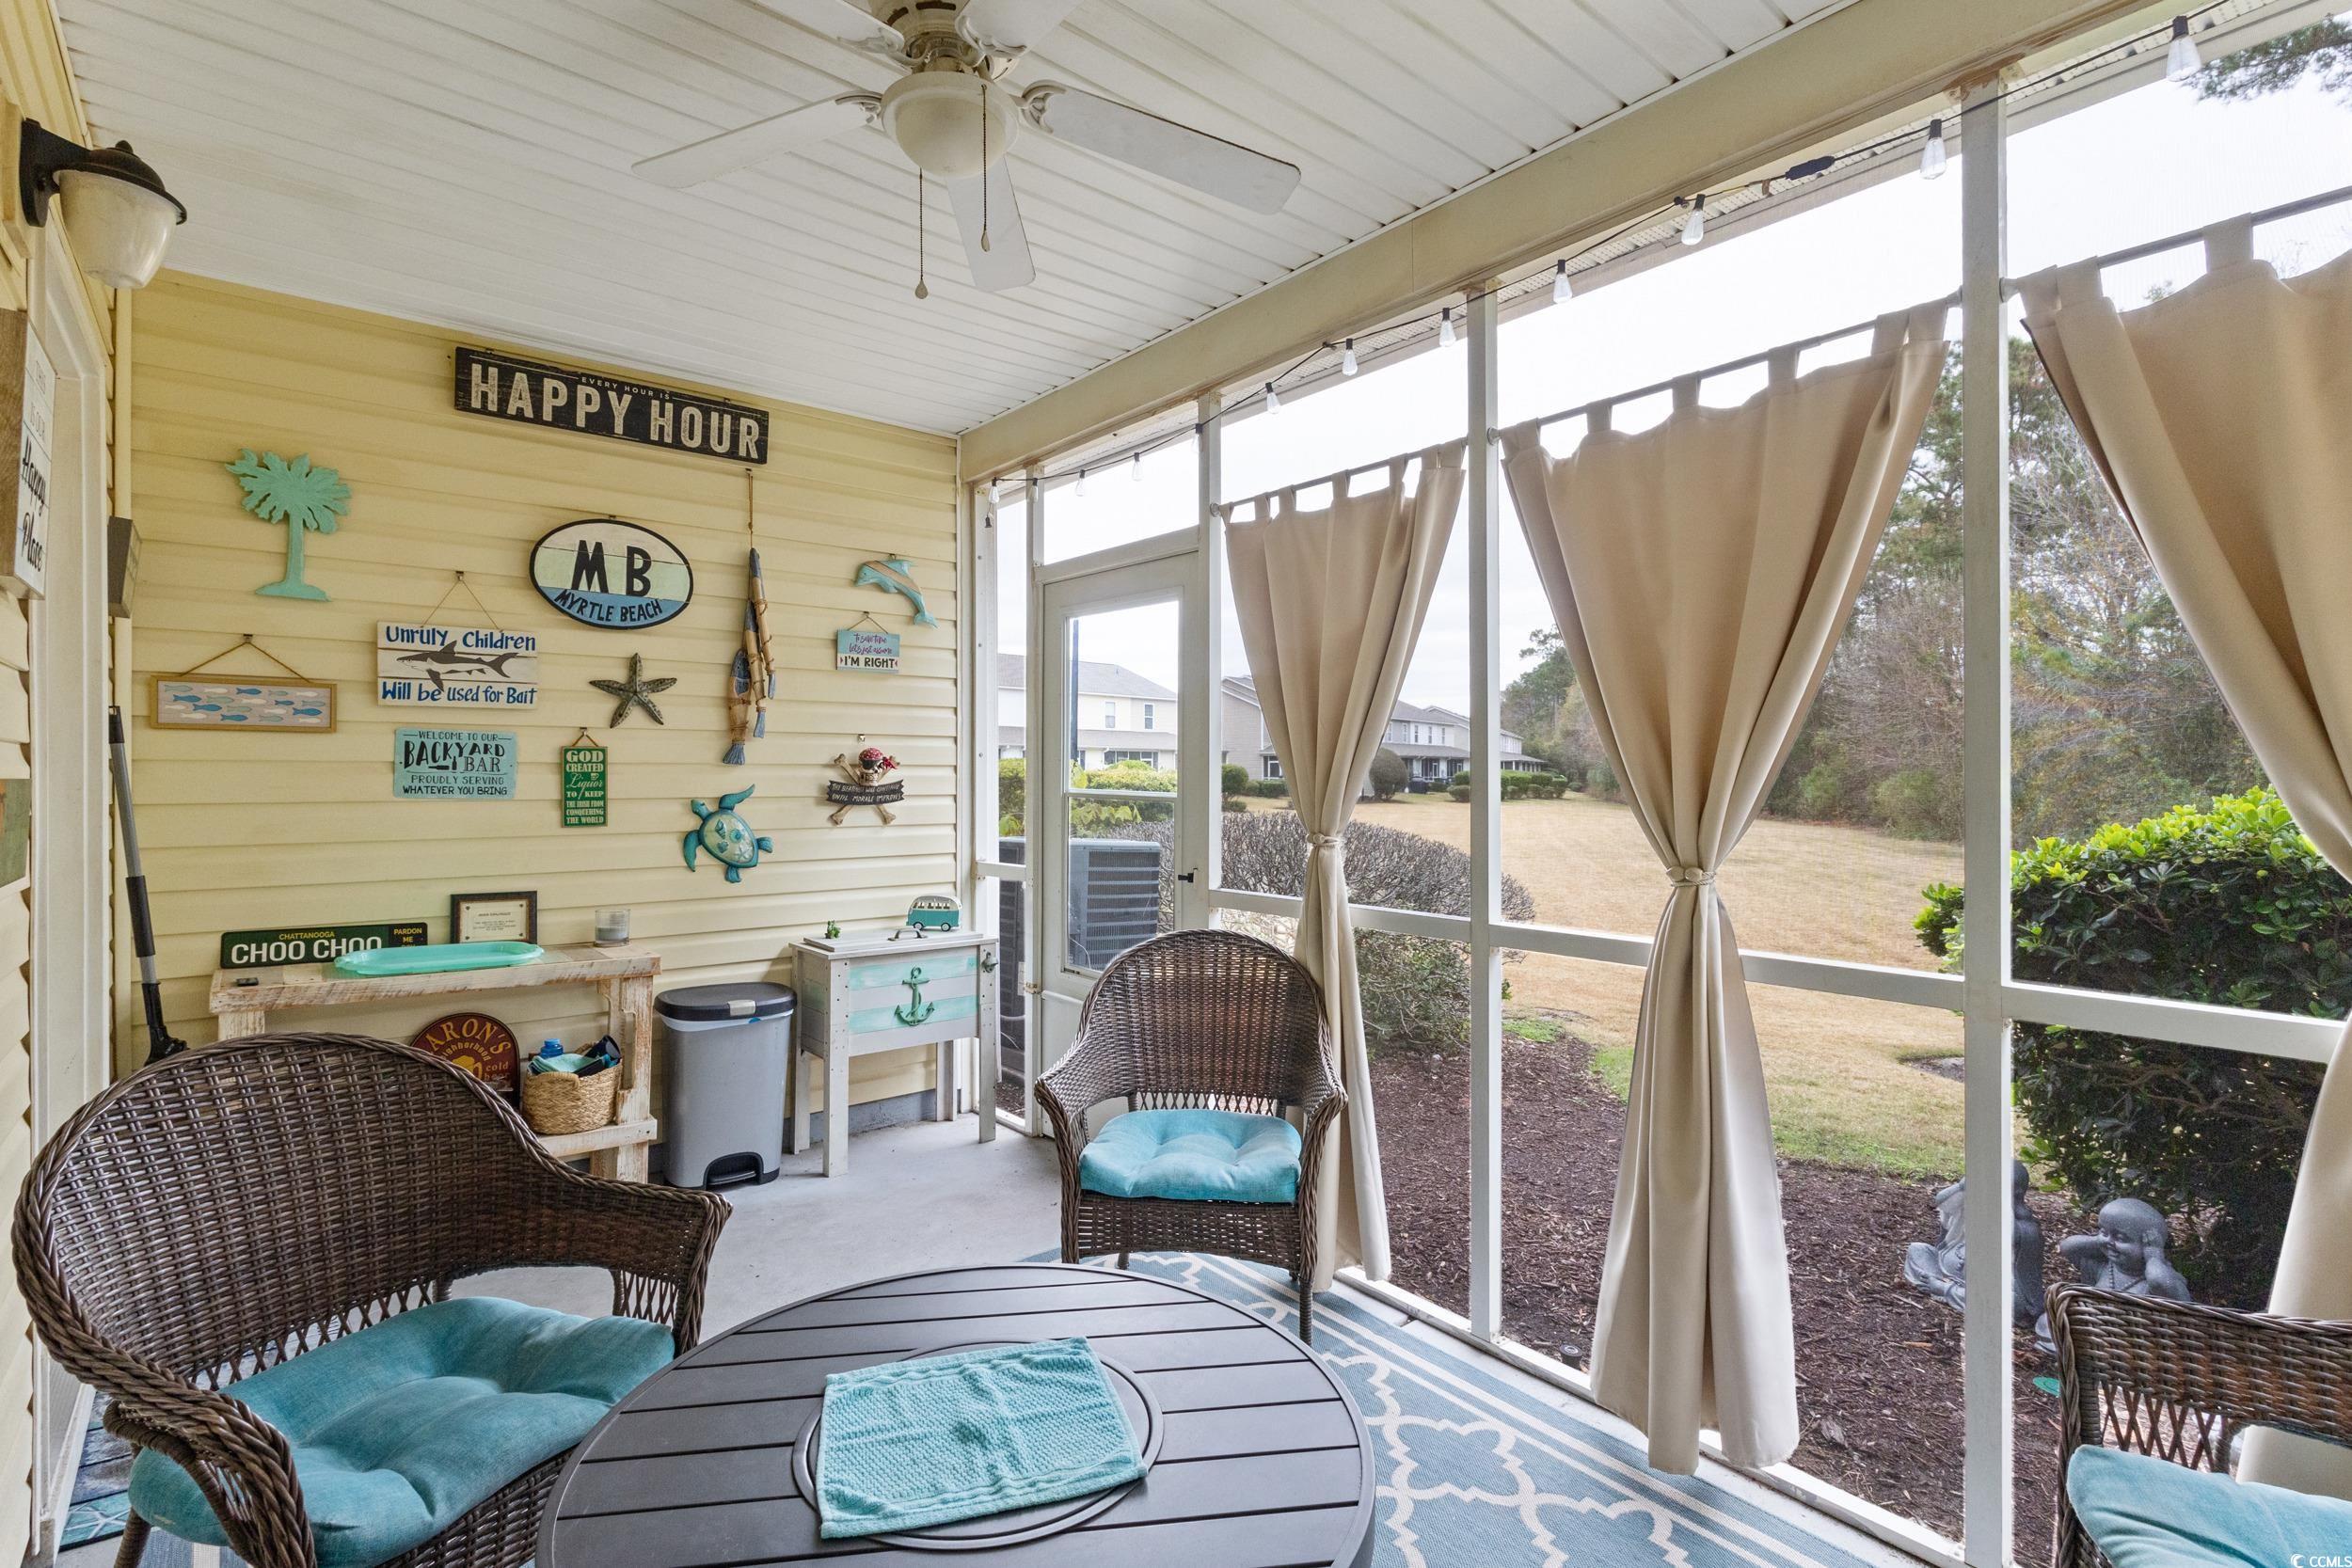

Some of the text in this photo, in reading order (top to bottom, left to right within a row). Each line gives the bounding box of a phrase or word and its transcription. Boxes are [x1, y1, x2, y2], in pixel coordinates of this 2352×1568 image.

[582, 376, 671, 400] EVERY HOUR IS
[471, 363, 760, 459] HAPPY HOUR
[22, 436, 47, 516] Happy
[22, 511, 43, 572] Place
[554, 589, 663, 623] MYRTLE BEACH
[386, 626, 536, 651] Unruly Children
[844, 656, 895, 668] I'M RIGHT
[382, 681, 538, 705] Will be used for Bait
[419, 731, 463, 740] WELCOME
[468, 733, 478, 741] TO
[404, 740, 505, 769] BACKYARD
[463, 755, 501, 772] BAR
[565, 750, 604, 763] GOD
[565, 763, 604, 772] CREATED
[411, 774, 504, 784] PROUDLY SERVING
[565, 772, 603, 800] Liquor
[403, 785, 507, 796] WHATEVER YOU BRING
[832, 793, 849, 801] UNTIL
[876, 793, 901, 801] IMPROVES
[278, 931, 335, 941] CHATTANOOGA
[230, 936, 382, 964] CHOO CHOO
[441, 1041, 492, 1061] ighborhood
[485, 1061, 509, 1071] cold
